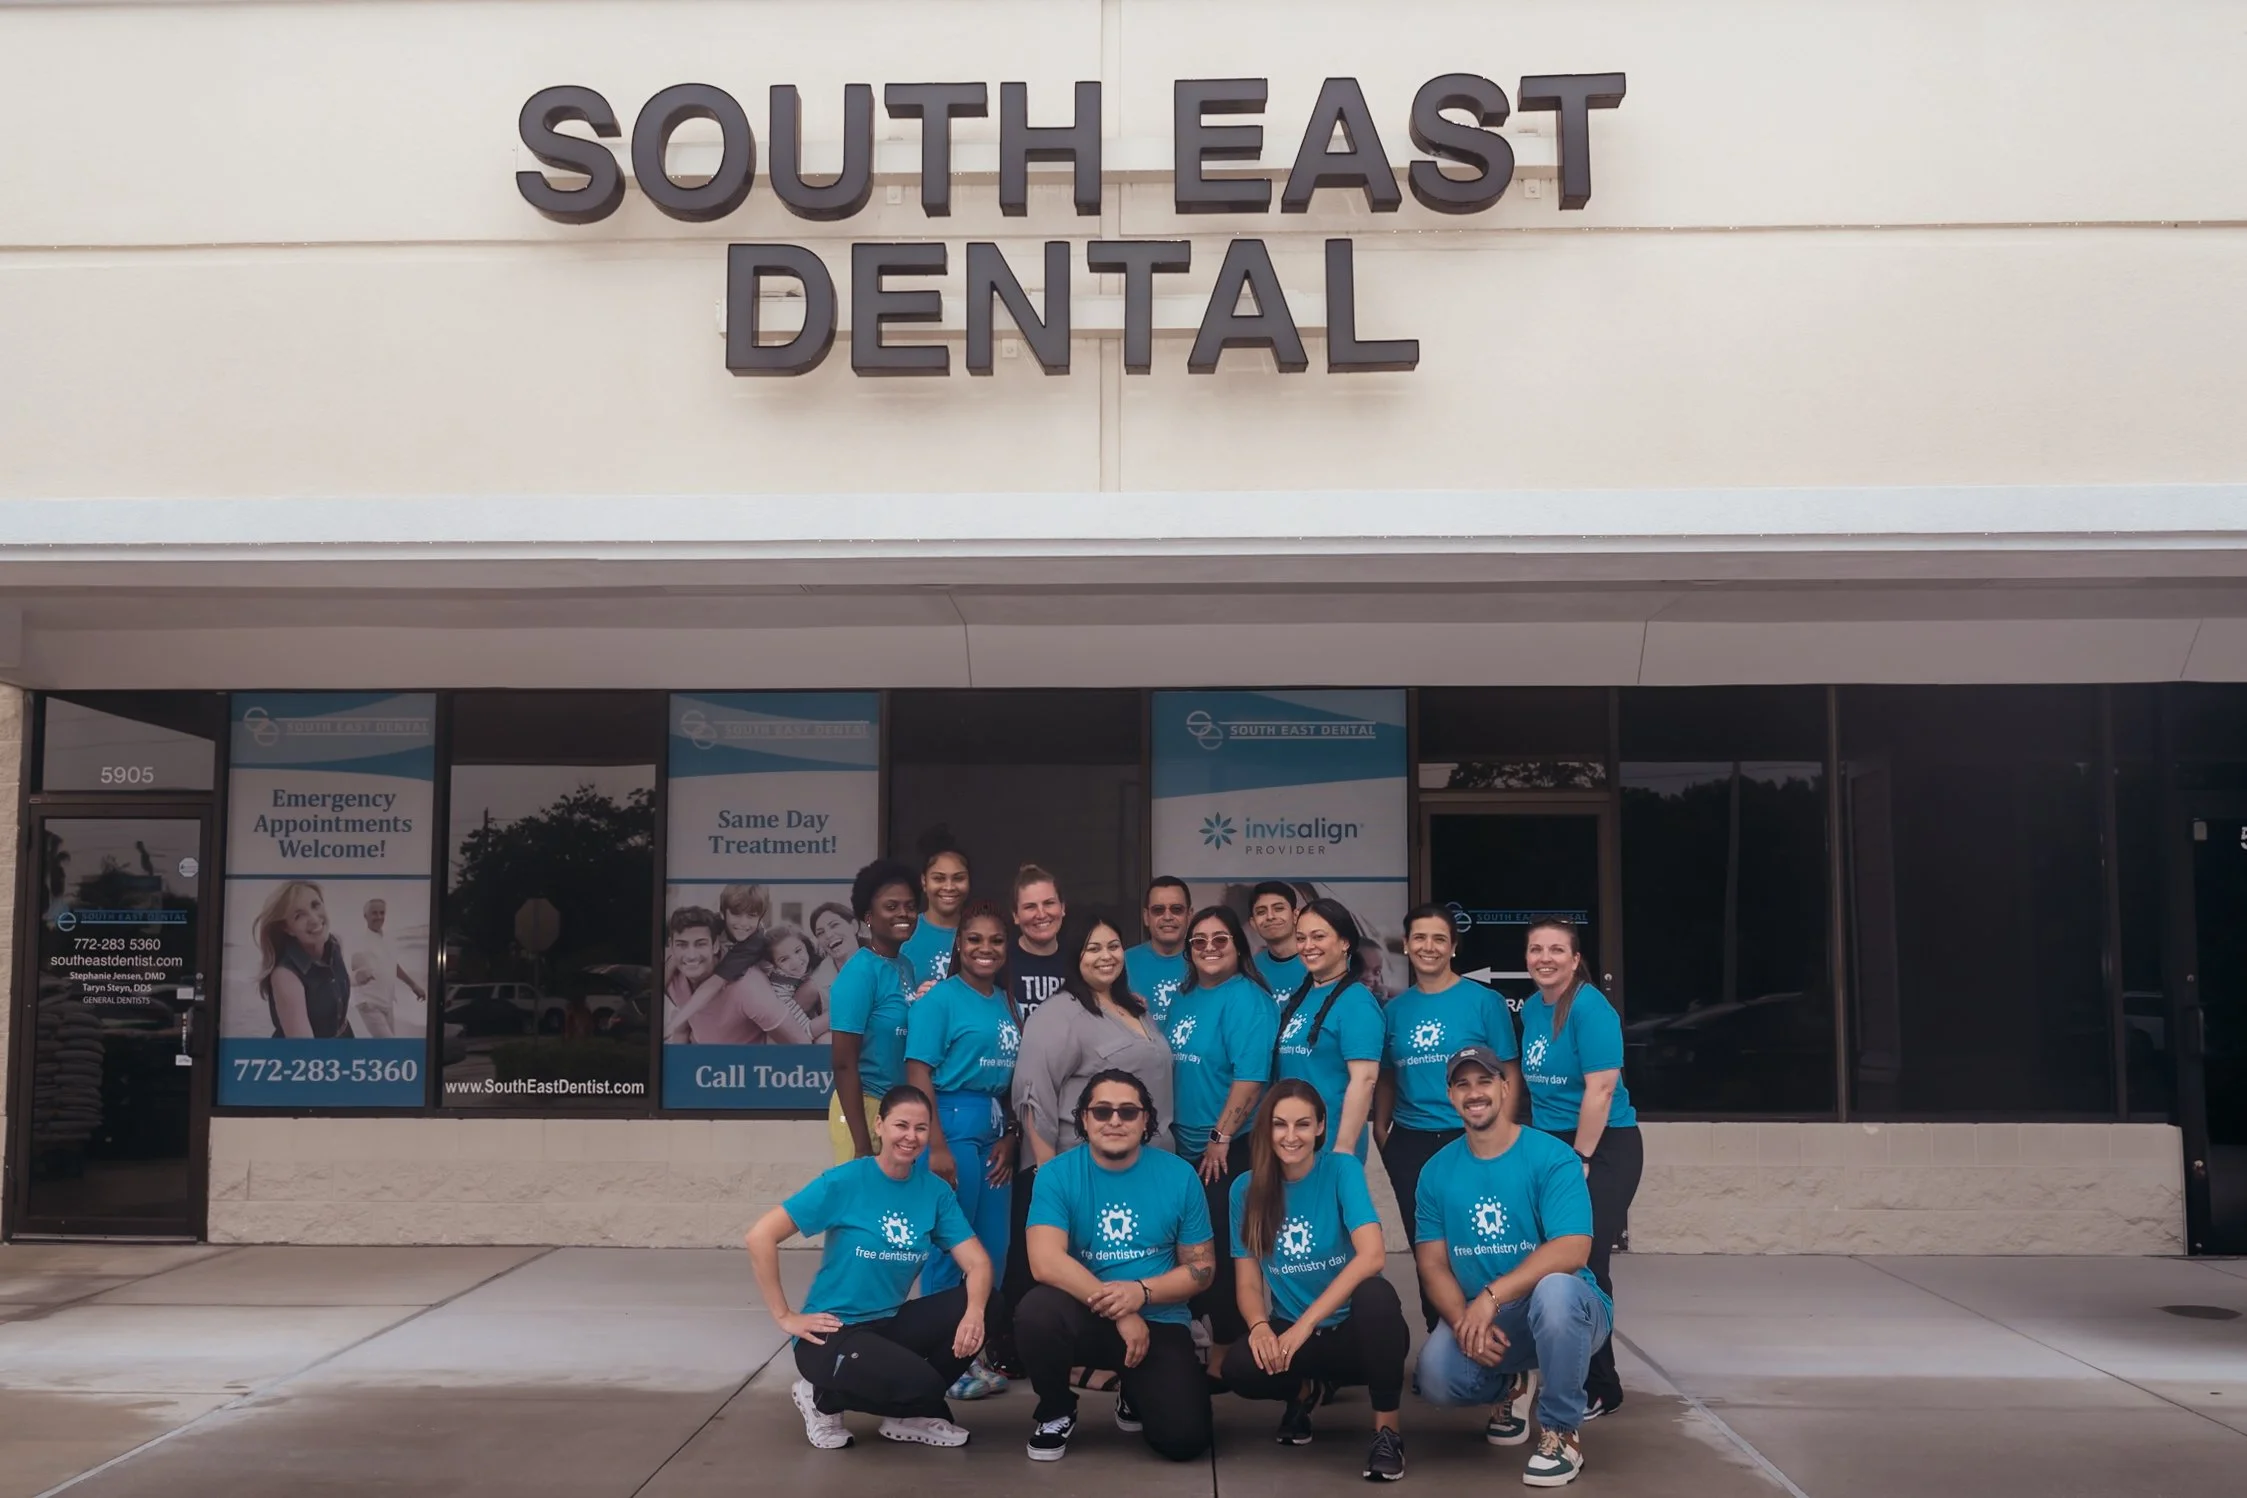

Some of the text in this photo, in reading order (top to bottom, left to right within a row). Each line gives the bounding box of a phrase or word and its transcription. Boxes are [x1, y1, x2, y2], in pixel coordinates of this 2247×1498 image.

[516, 72, 1626, 224] SOUTH EAST
[725, 237, 1420, 377] DENTAL
[286, 721, 429, 732] SOUTH EAST DENTAL
[725, 724, 869, 736] SOUTH EAST DENTAL
[1230, 725, 1376, 736] SOUTH EAST DENTAL
[100, 766, 154, 784] 5905
[272, 788, 397, 813] Emergency
[254, 814, 413, 838] Appointments
[717, 809, 829, 833] Same Day
[1245, 818, 1358, 845] invisalign
[279, 839, 386, 859] Welcome!
[708, 836, 837, 854] Treatment!
[1245, 845, 1327, 855] PROVIDER
[1476, 913, 1512, 921] SOUTH
[74, 938, 161, 950] 772-283 5360
[50, 954, 183, 967] southeastdentist.com
[69, 971, 166, 981] Stephanie Jensen, DMD
[82, 983, 152, 993] Taryn Steyn, DDS
[83, 996, 151, 1004] GENERAL DENTISTS
[1295, 1044, 1312, 1057] day
[1407, 1053, 1450, 1065] dentistry
[233, 1058, 418, 1083] 772-283-5360
[695, 1064, 834, 1094] Call Today
[1550, 1075, 1568, 1085] day
[445, 1078, 644, 1095] www.SouthEastDentist.com
[855, 1245, 877, 1260] free
[878, 1250, 922, 1263] dentistry
[1095, 1249, 1145, 1261] dentistry
[1454, 1245, 1473, 1256] free
[1474, 1243, 1518, 1255] dentistry
[1281, 1260, 1327, 1275] dentistry
[1328, 1253, 1346, 1267] day
